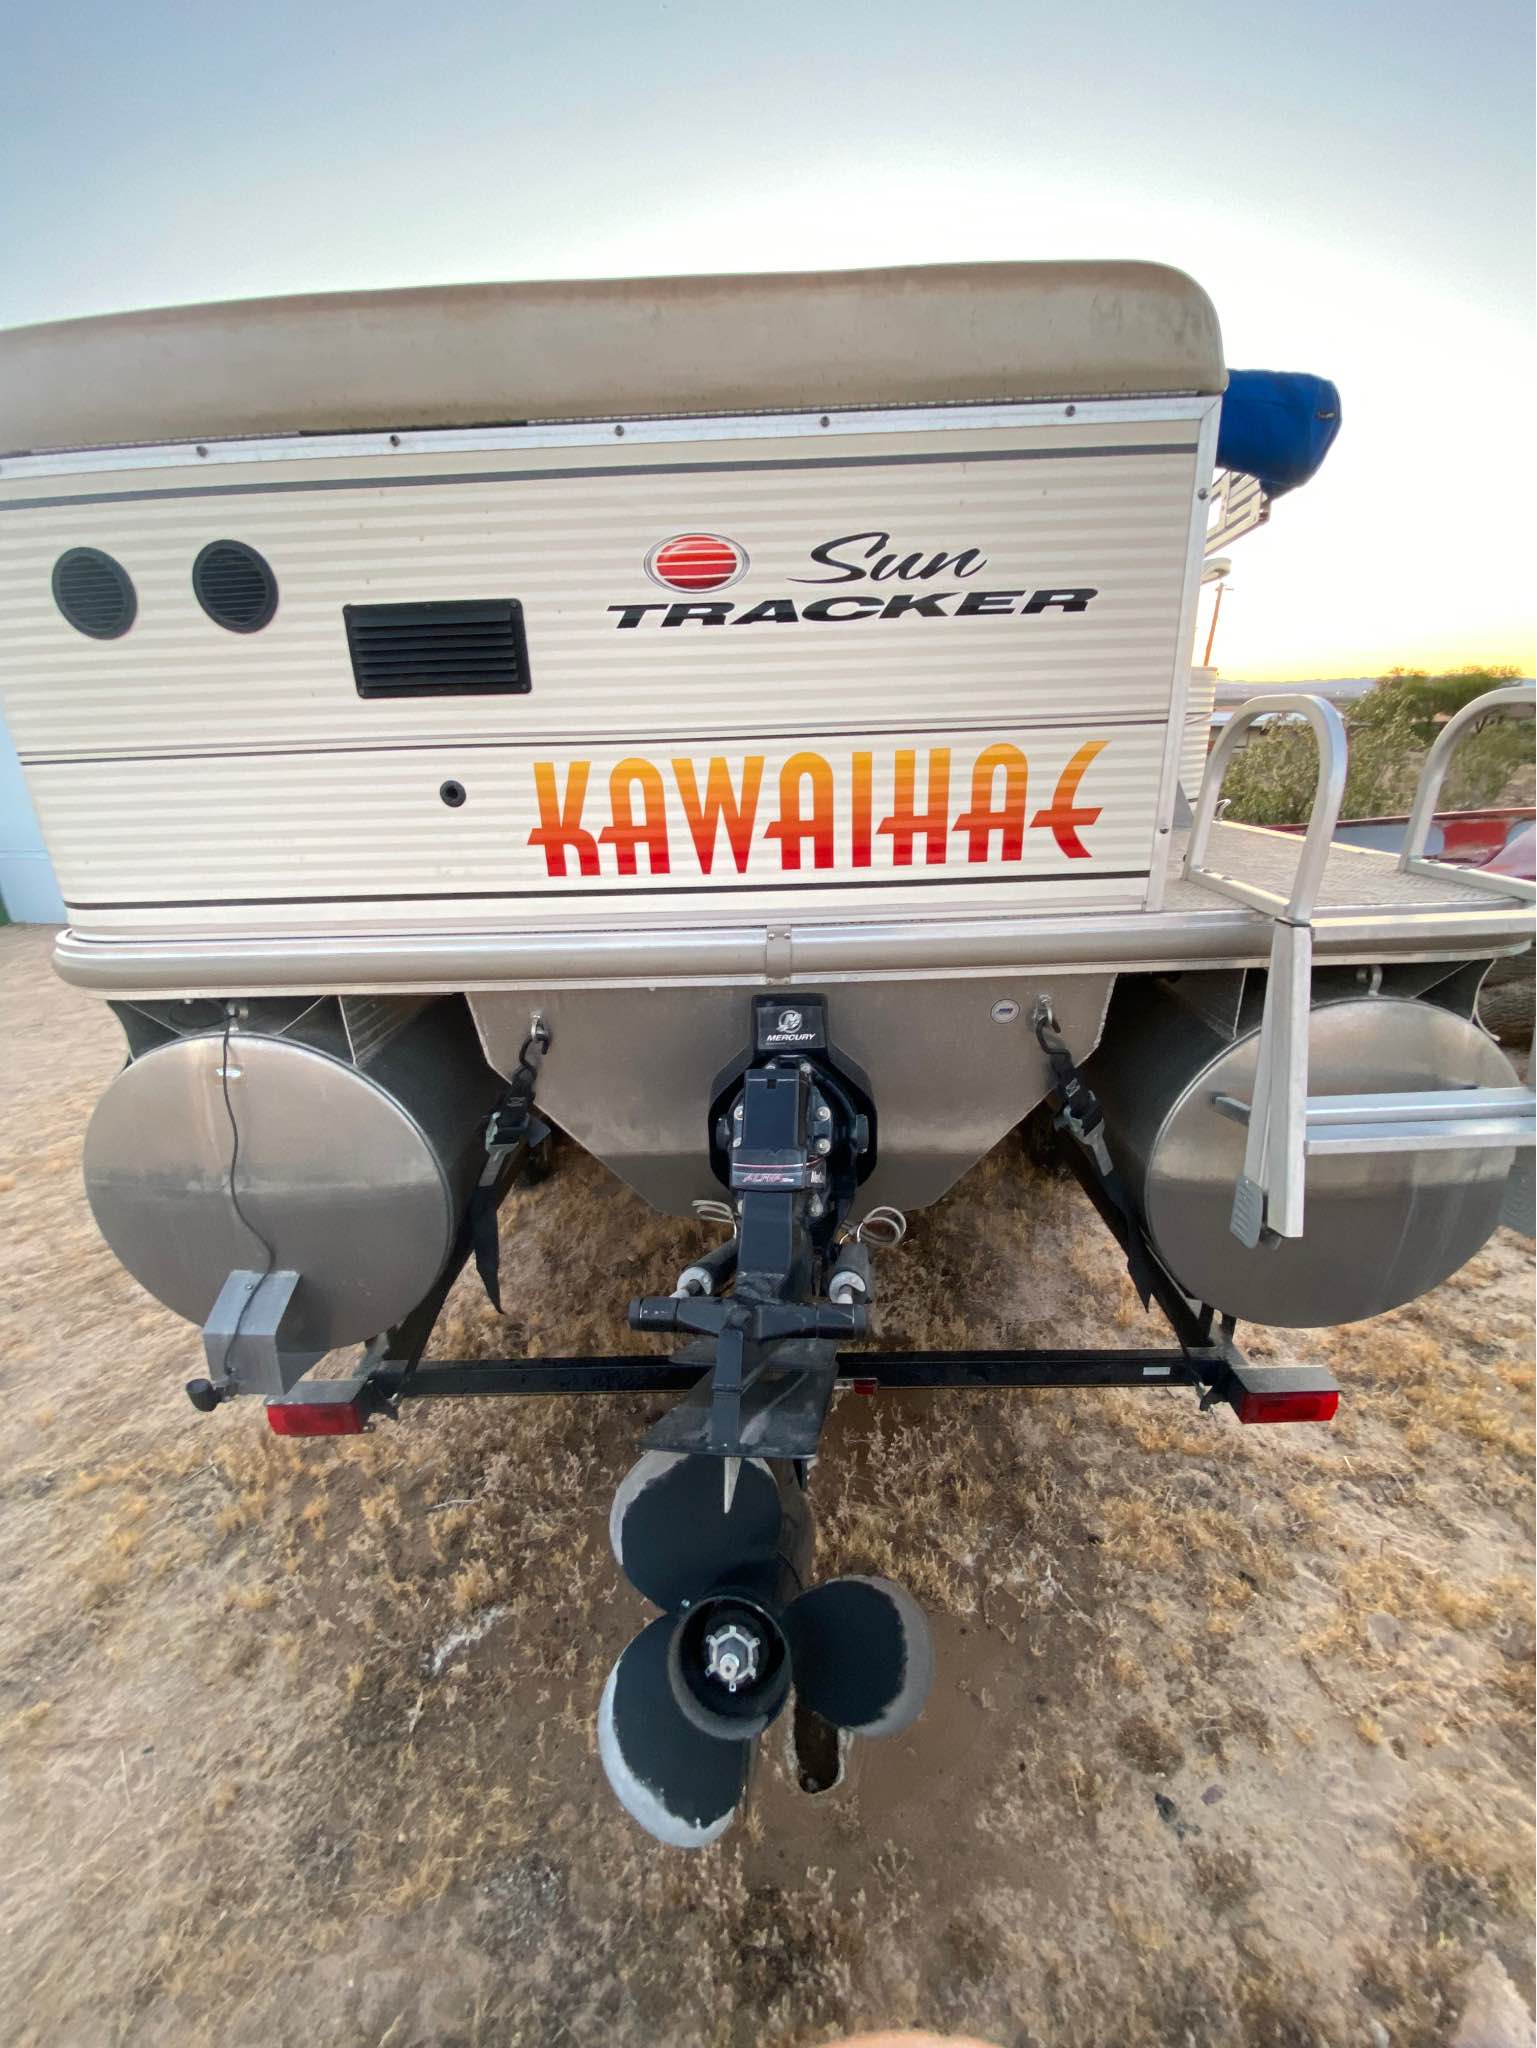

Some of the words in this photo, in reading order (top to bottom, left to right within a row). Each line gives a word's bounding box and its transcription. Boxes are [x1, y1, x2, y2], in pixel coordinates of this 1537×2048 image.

[786, 531, 988, 584] Sun
[606, 588, 1099, 629] TRACKER
[766, 1033, 816, 1042] MERCURY
